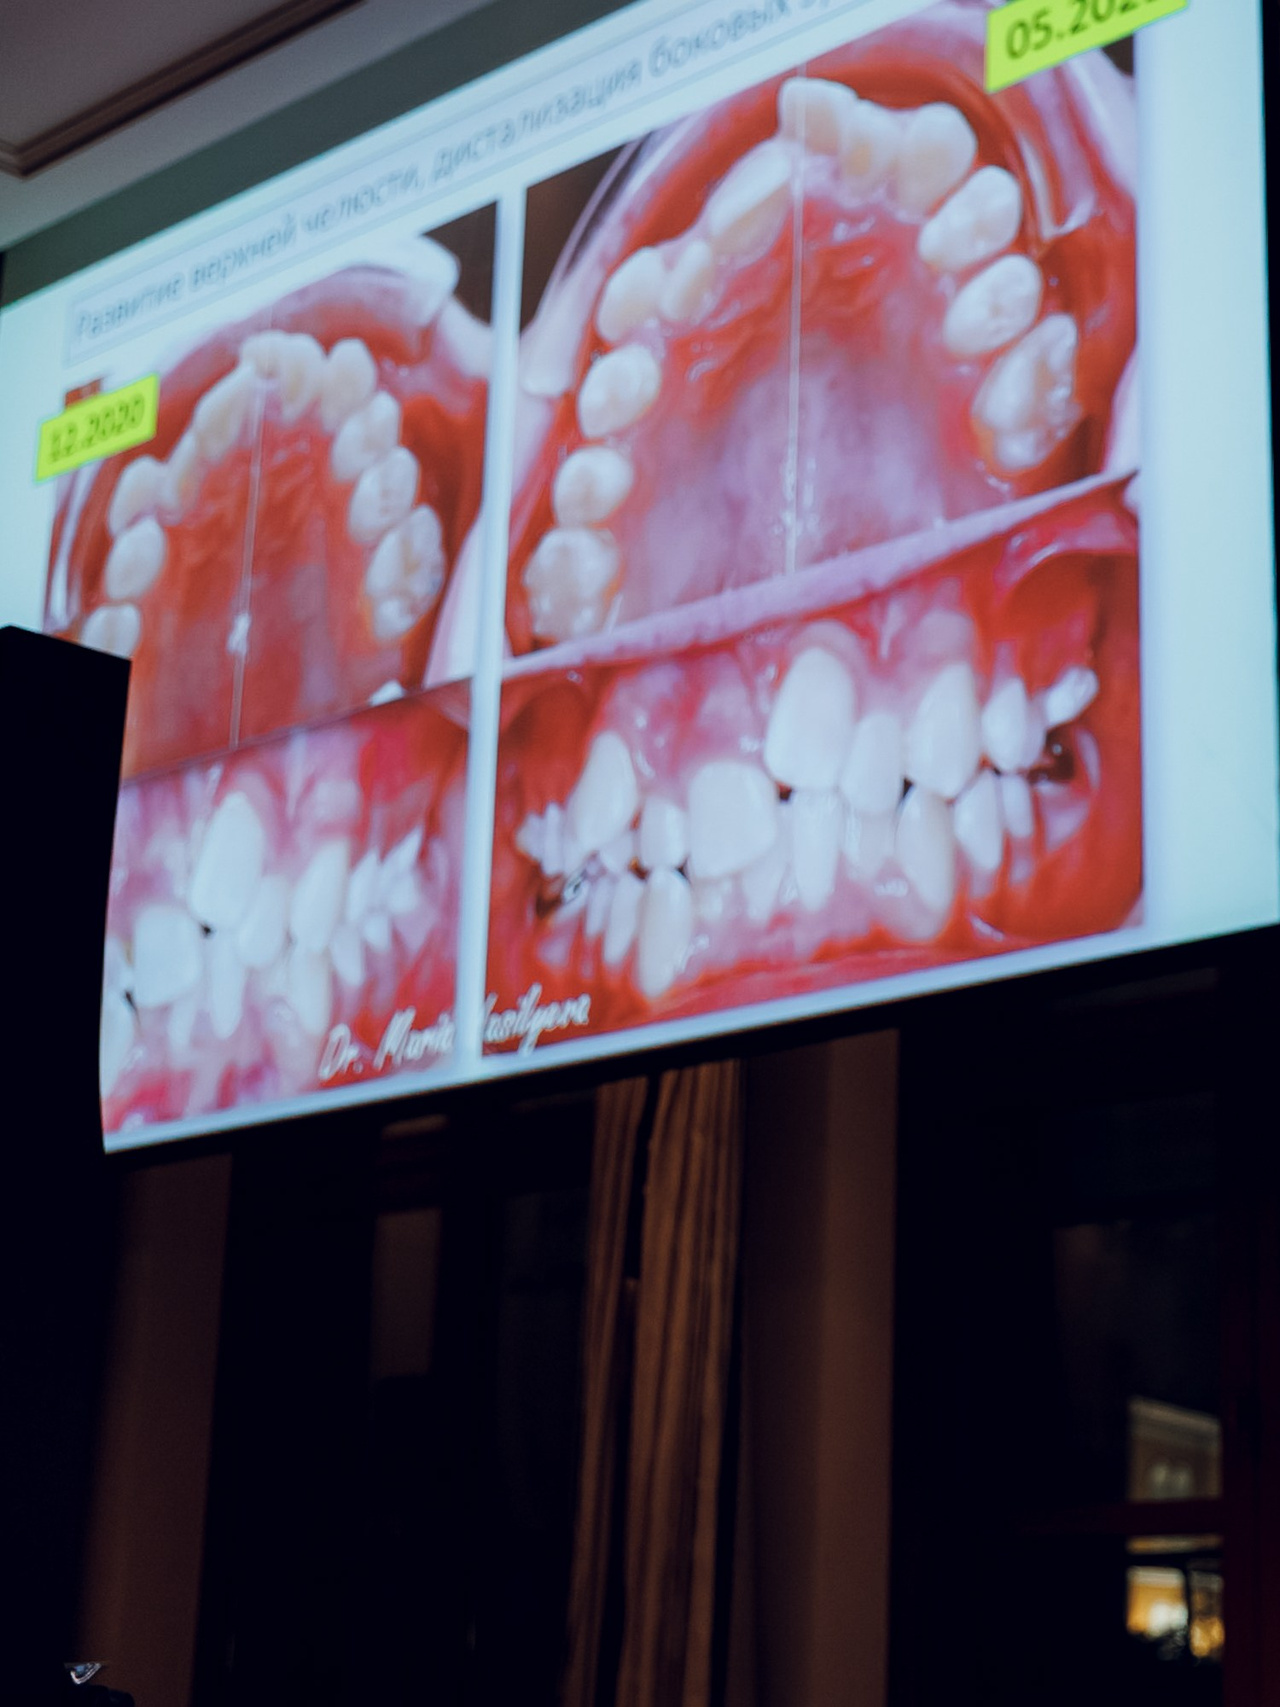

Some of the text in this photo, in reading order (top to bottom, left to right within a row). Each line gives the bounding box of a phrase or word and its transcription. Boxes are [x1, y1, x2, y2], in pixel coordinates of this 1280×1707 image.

[1006, 0, 1158, 59] 05.20
[190, 213, 296, 290] верхней
[319, 1022, 363, 1080] Dr.
